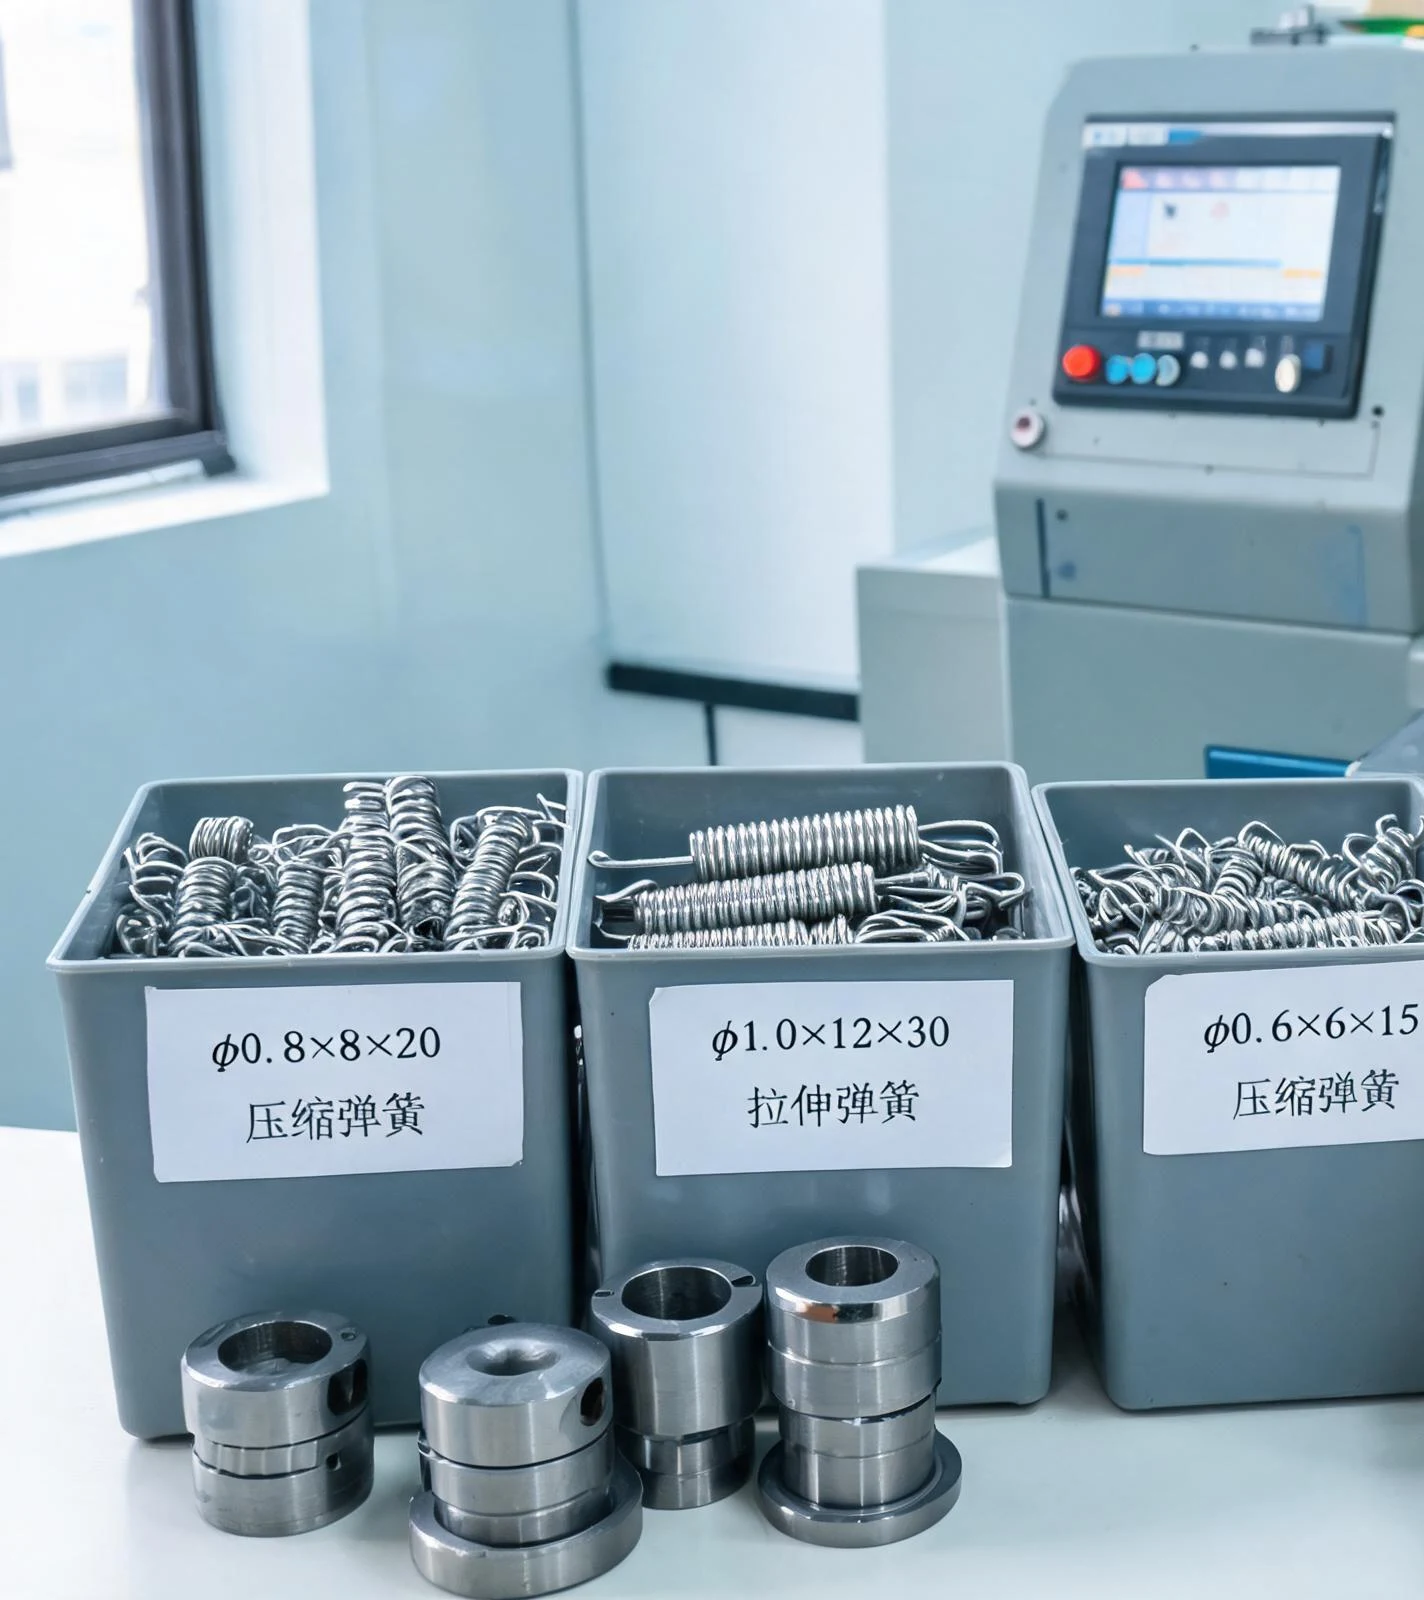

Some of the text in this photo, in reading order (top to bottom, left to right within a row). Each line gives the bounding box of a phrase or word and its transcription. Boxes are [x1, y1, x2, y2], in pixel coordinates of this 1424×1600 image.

[246, 1092, 425, 1143] 压缩弹簧
[748, 1080, 920, 1128] 拉伸弹簧
[1233, 1069, 1400, 1120] 压缩弹簧
